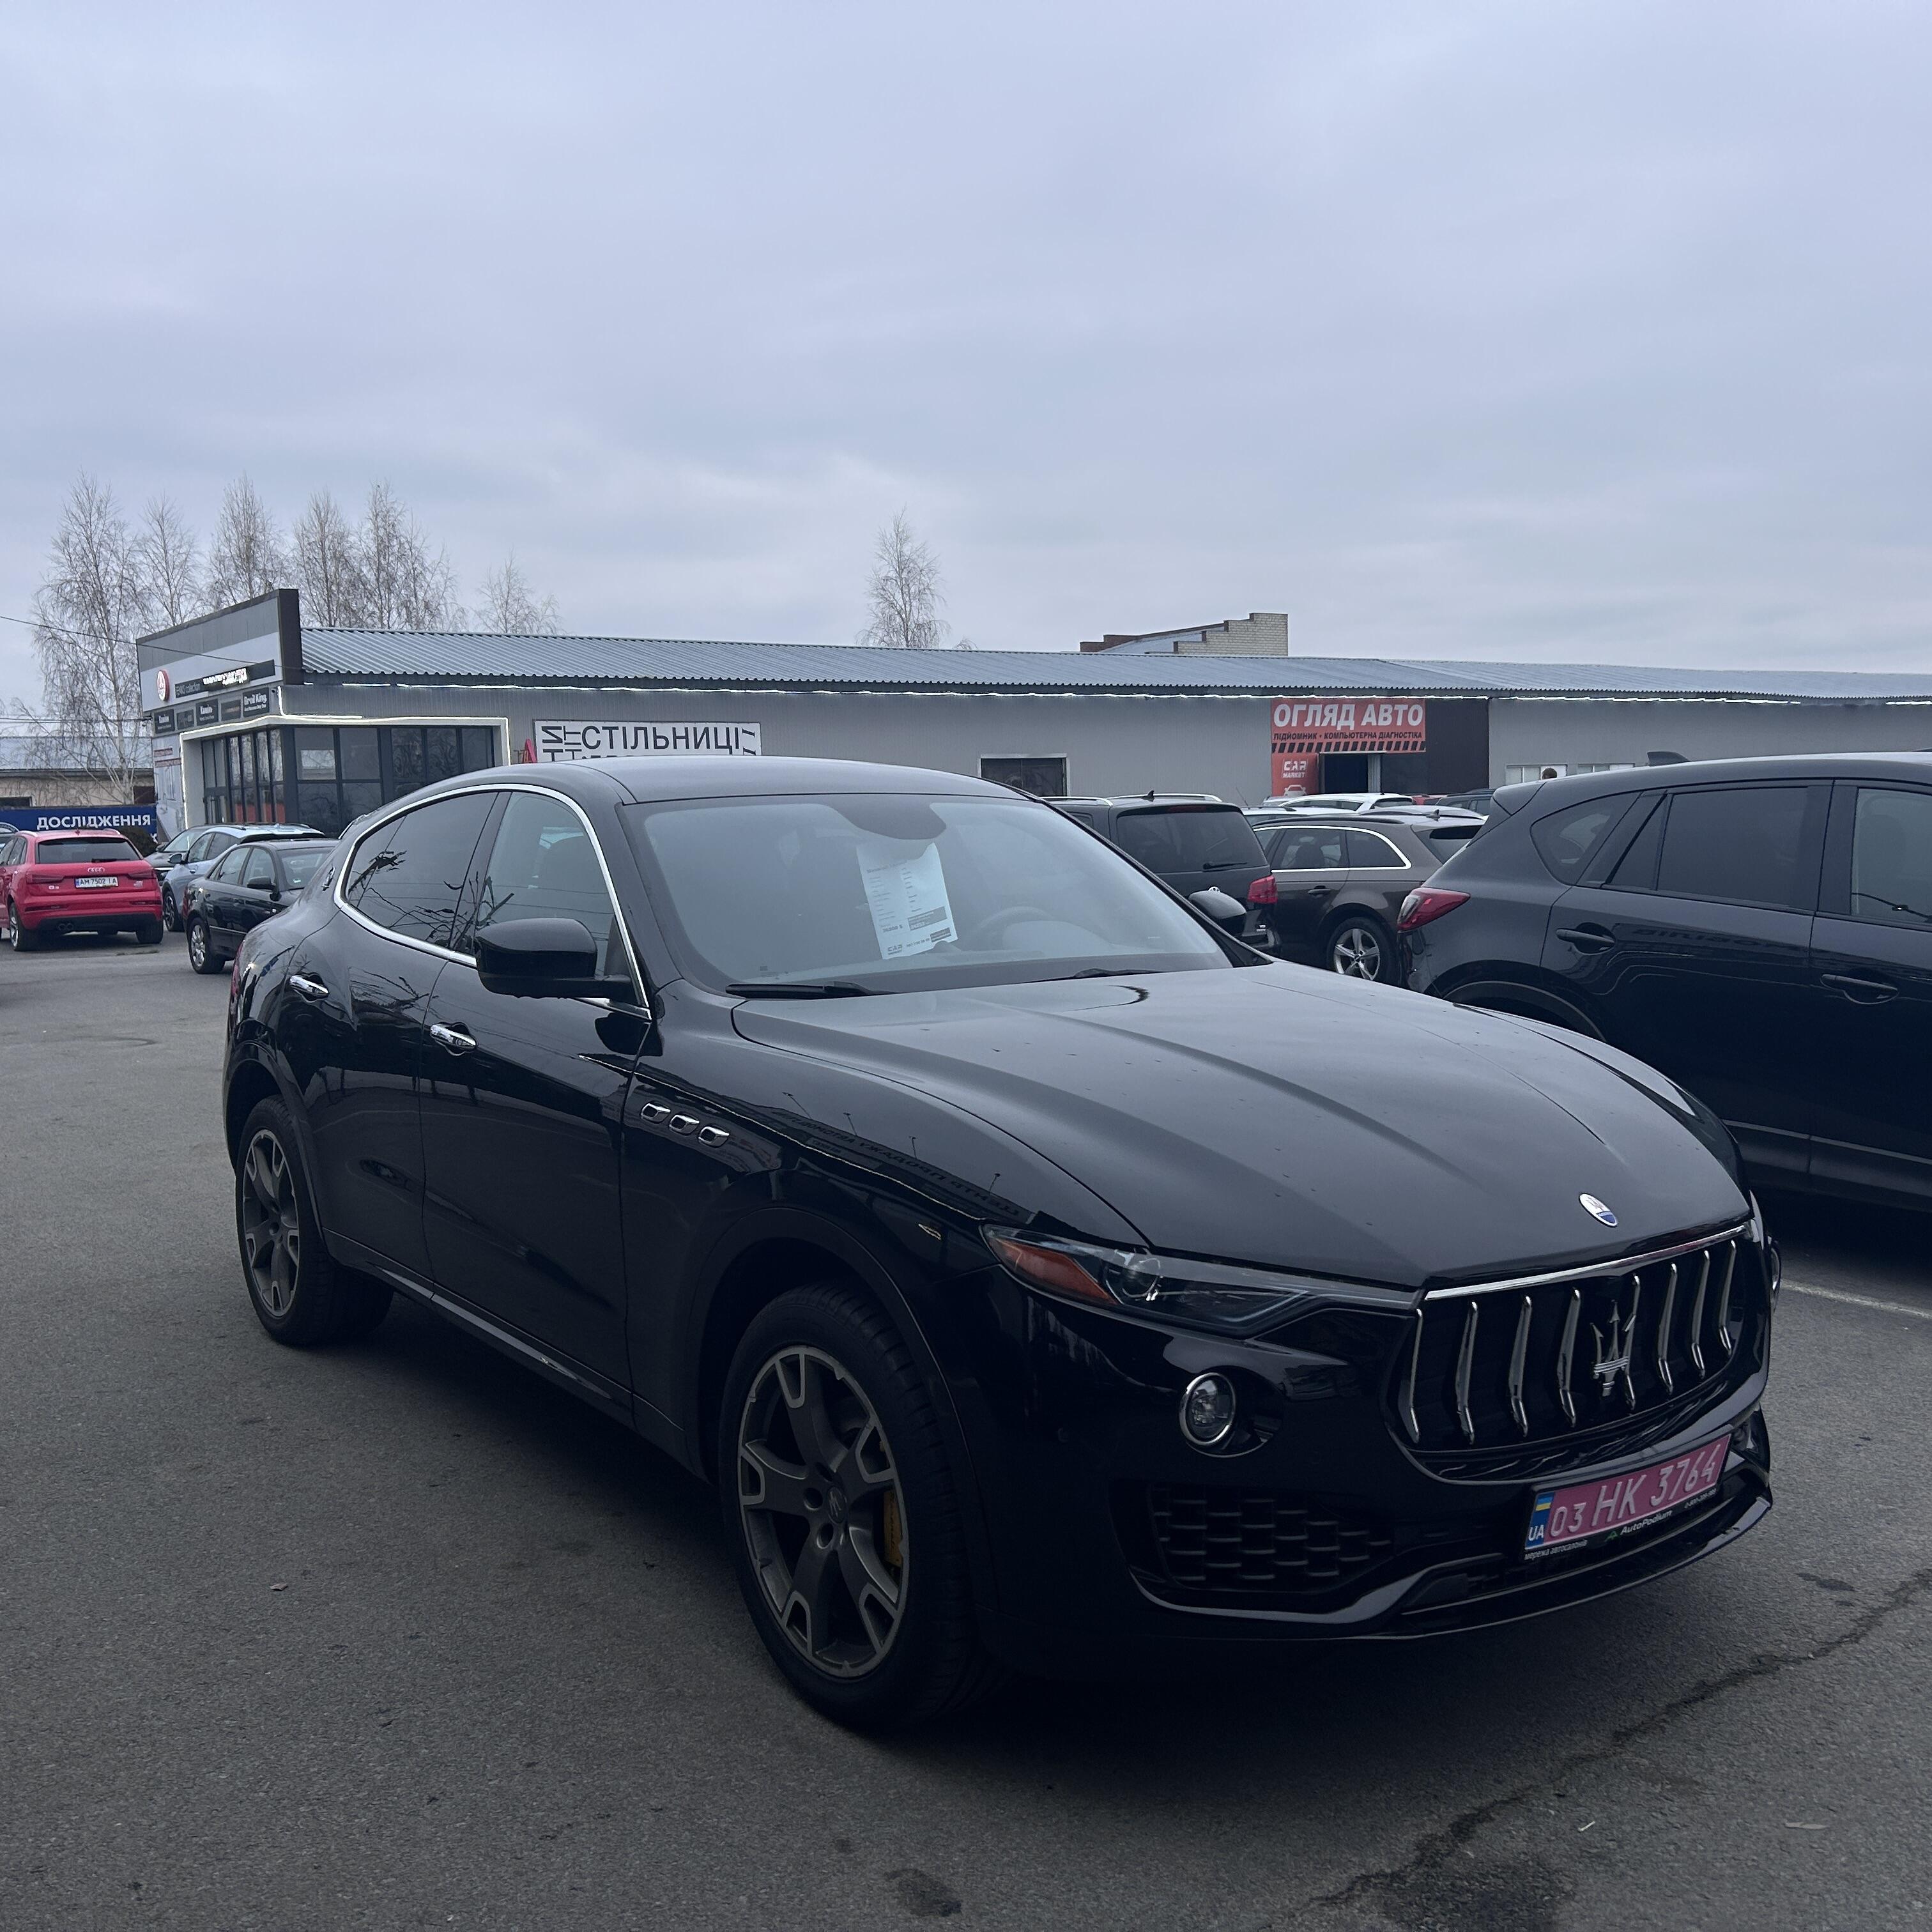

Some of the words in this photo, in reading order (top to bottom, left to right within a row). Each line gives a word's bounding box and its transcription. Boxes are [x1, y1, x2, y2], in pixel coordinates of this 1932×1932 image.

[256, 692, 267, 703] King
[1274, 704, 1355, 731] ОГЛЯД
[1361, 704, 1423, 726] АВТО
[581, 726, 740, 755] СТІЛЬНИЦІ
[1274, 732, 1317, 740] ПІДЙОМНИК
[1378, 732, 1422, 740] ДІАГНОСТІКА
[1284, 760, 1307, 771] CAR
[36, 815, 151, 830] ДОСЛІДЖЕННЯ
[1550, 1502, 1586, 1537] 03
[1651, 1444, 1721, 1506] 3764
[1620, 1510, 1673, 1535] AutoPodium
[1528, 1524, 1545, 1541] UA
